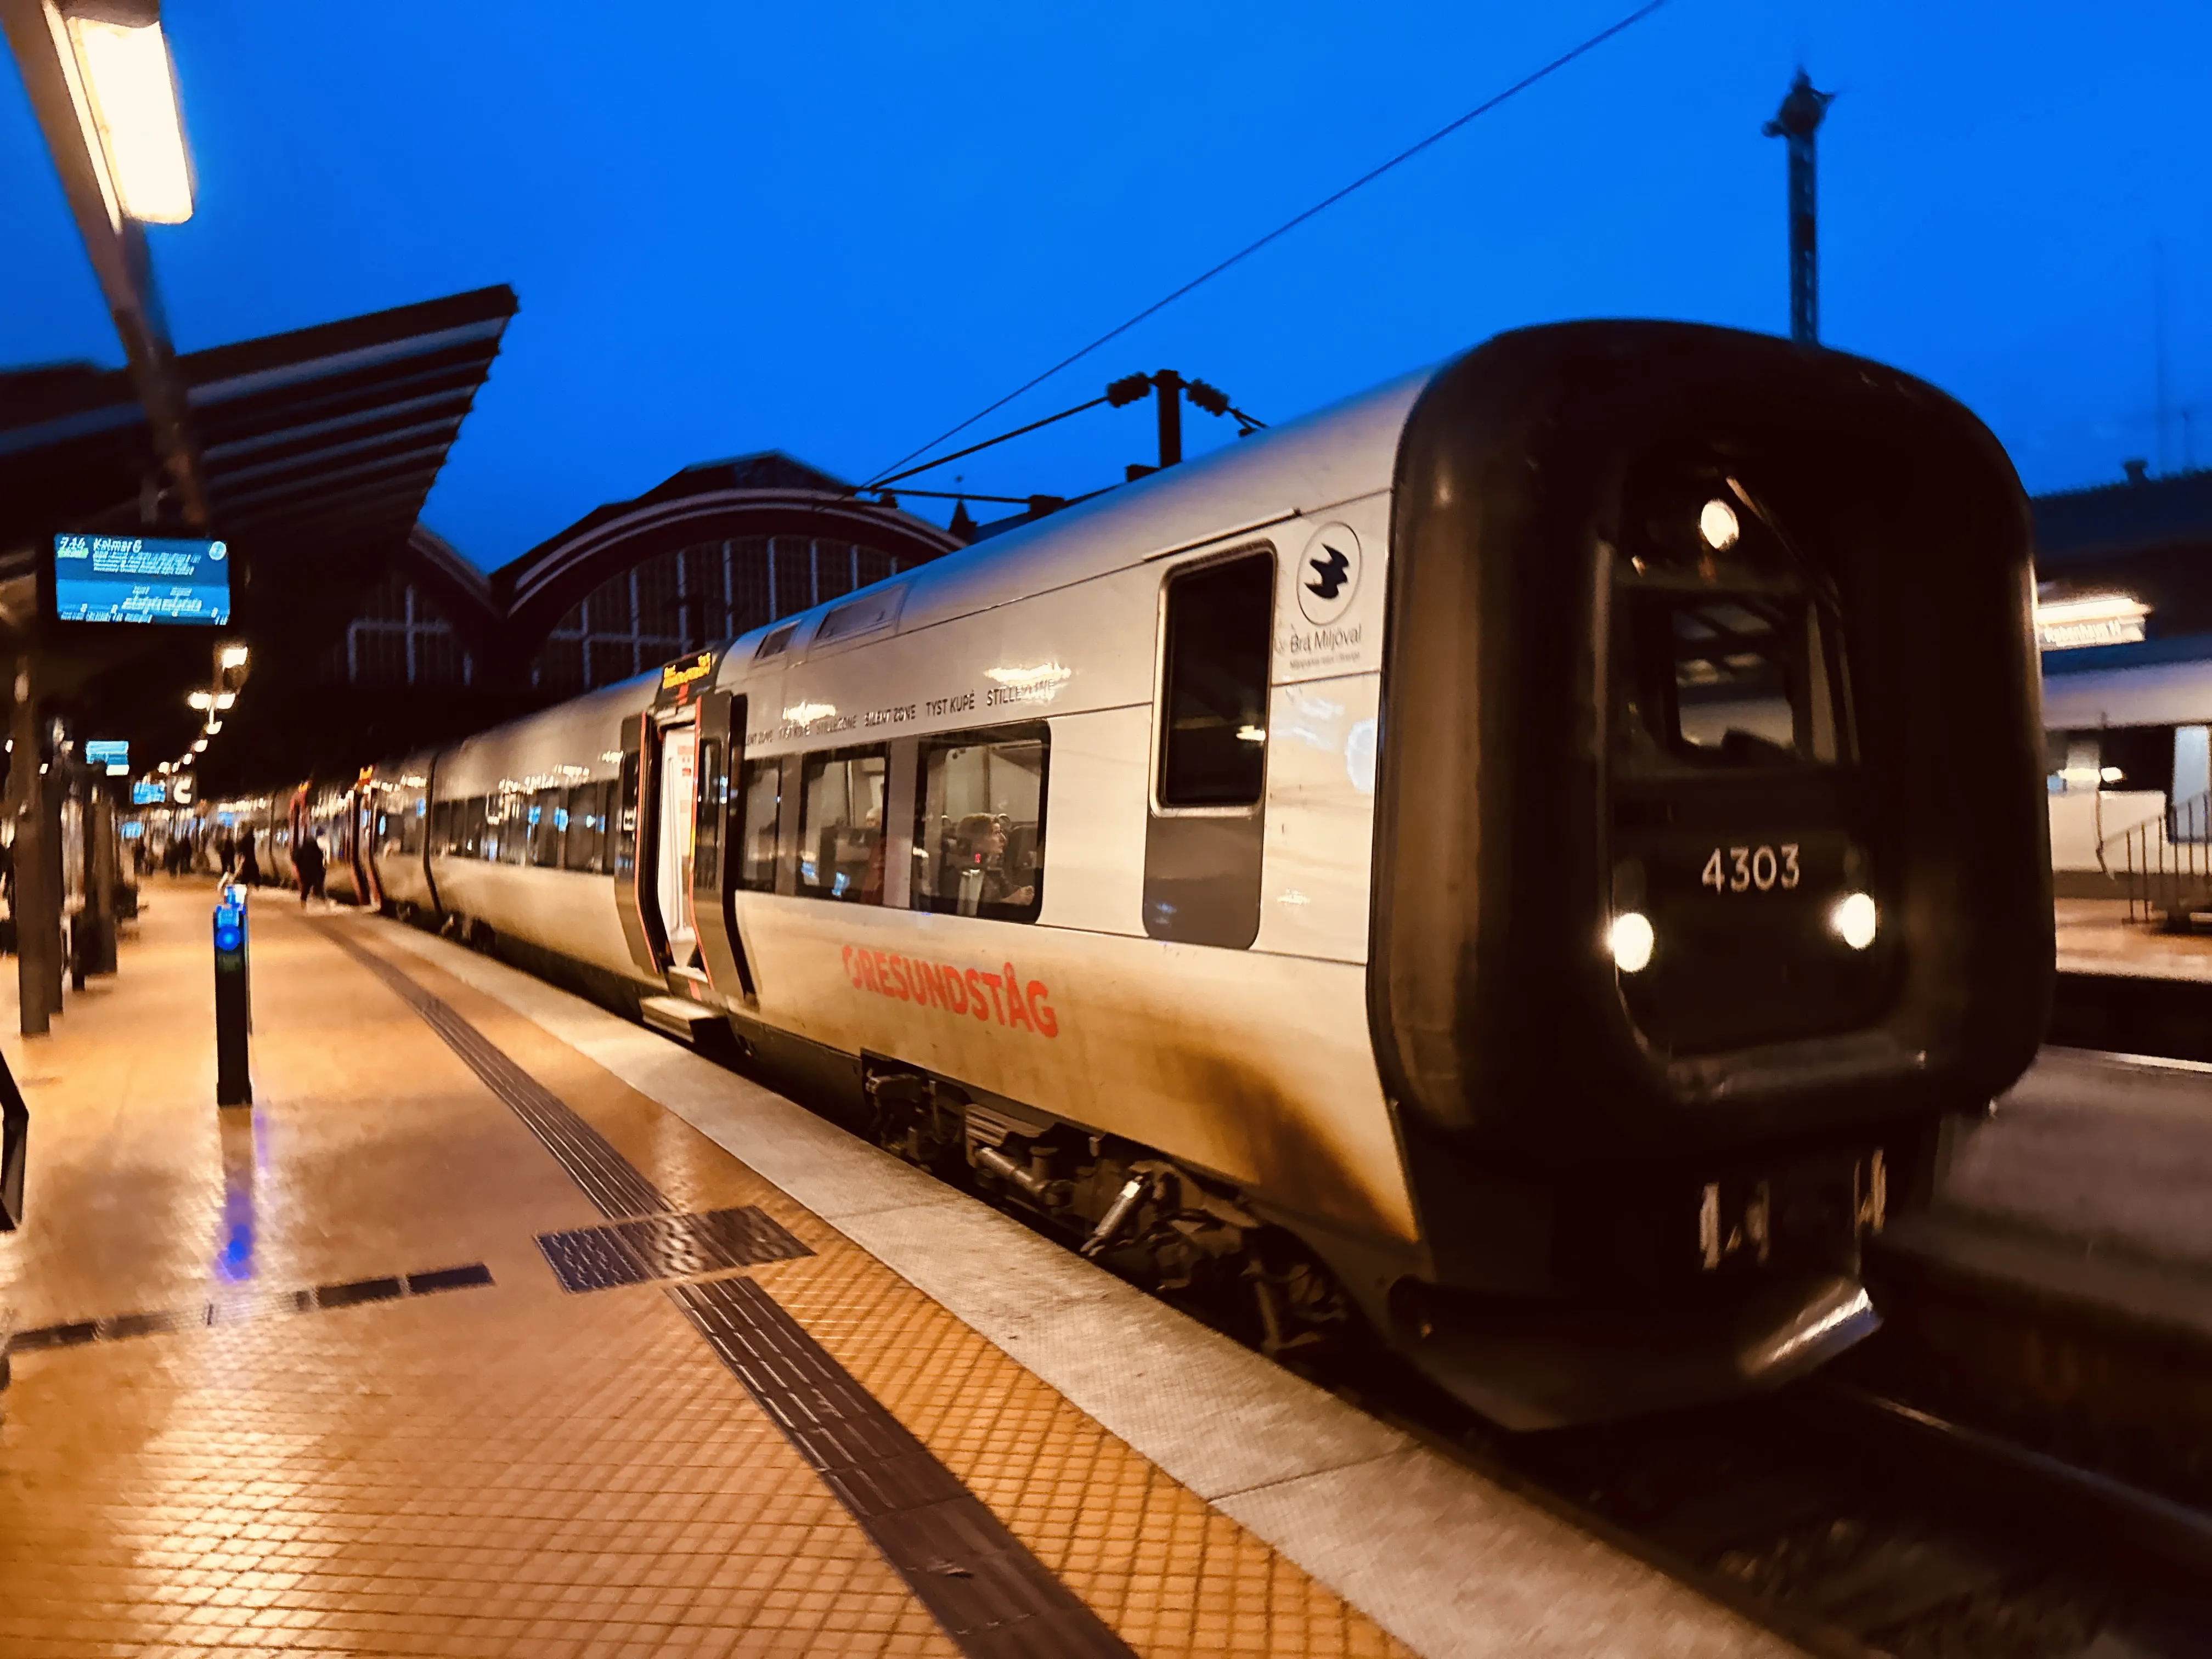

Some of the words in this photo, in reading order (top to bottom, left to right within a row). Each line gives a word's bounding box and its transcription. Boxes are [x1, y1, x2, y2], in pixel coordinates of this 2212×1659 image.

[93, 538, 133, 552] Kalmar
[1291, 633, 1311, 653] Bra
[865, 708, 891, 727] SILENT
[893, 704, 916, 723] ZONE
[926, 698, 948, 717] TYST
[950, 689, 975, 712] KUPÉ
[1702, 843, 1800, 895] 4303
[842, 945, 1058, 1039] ØRESUNDSTÅG
